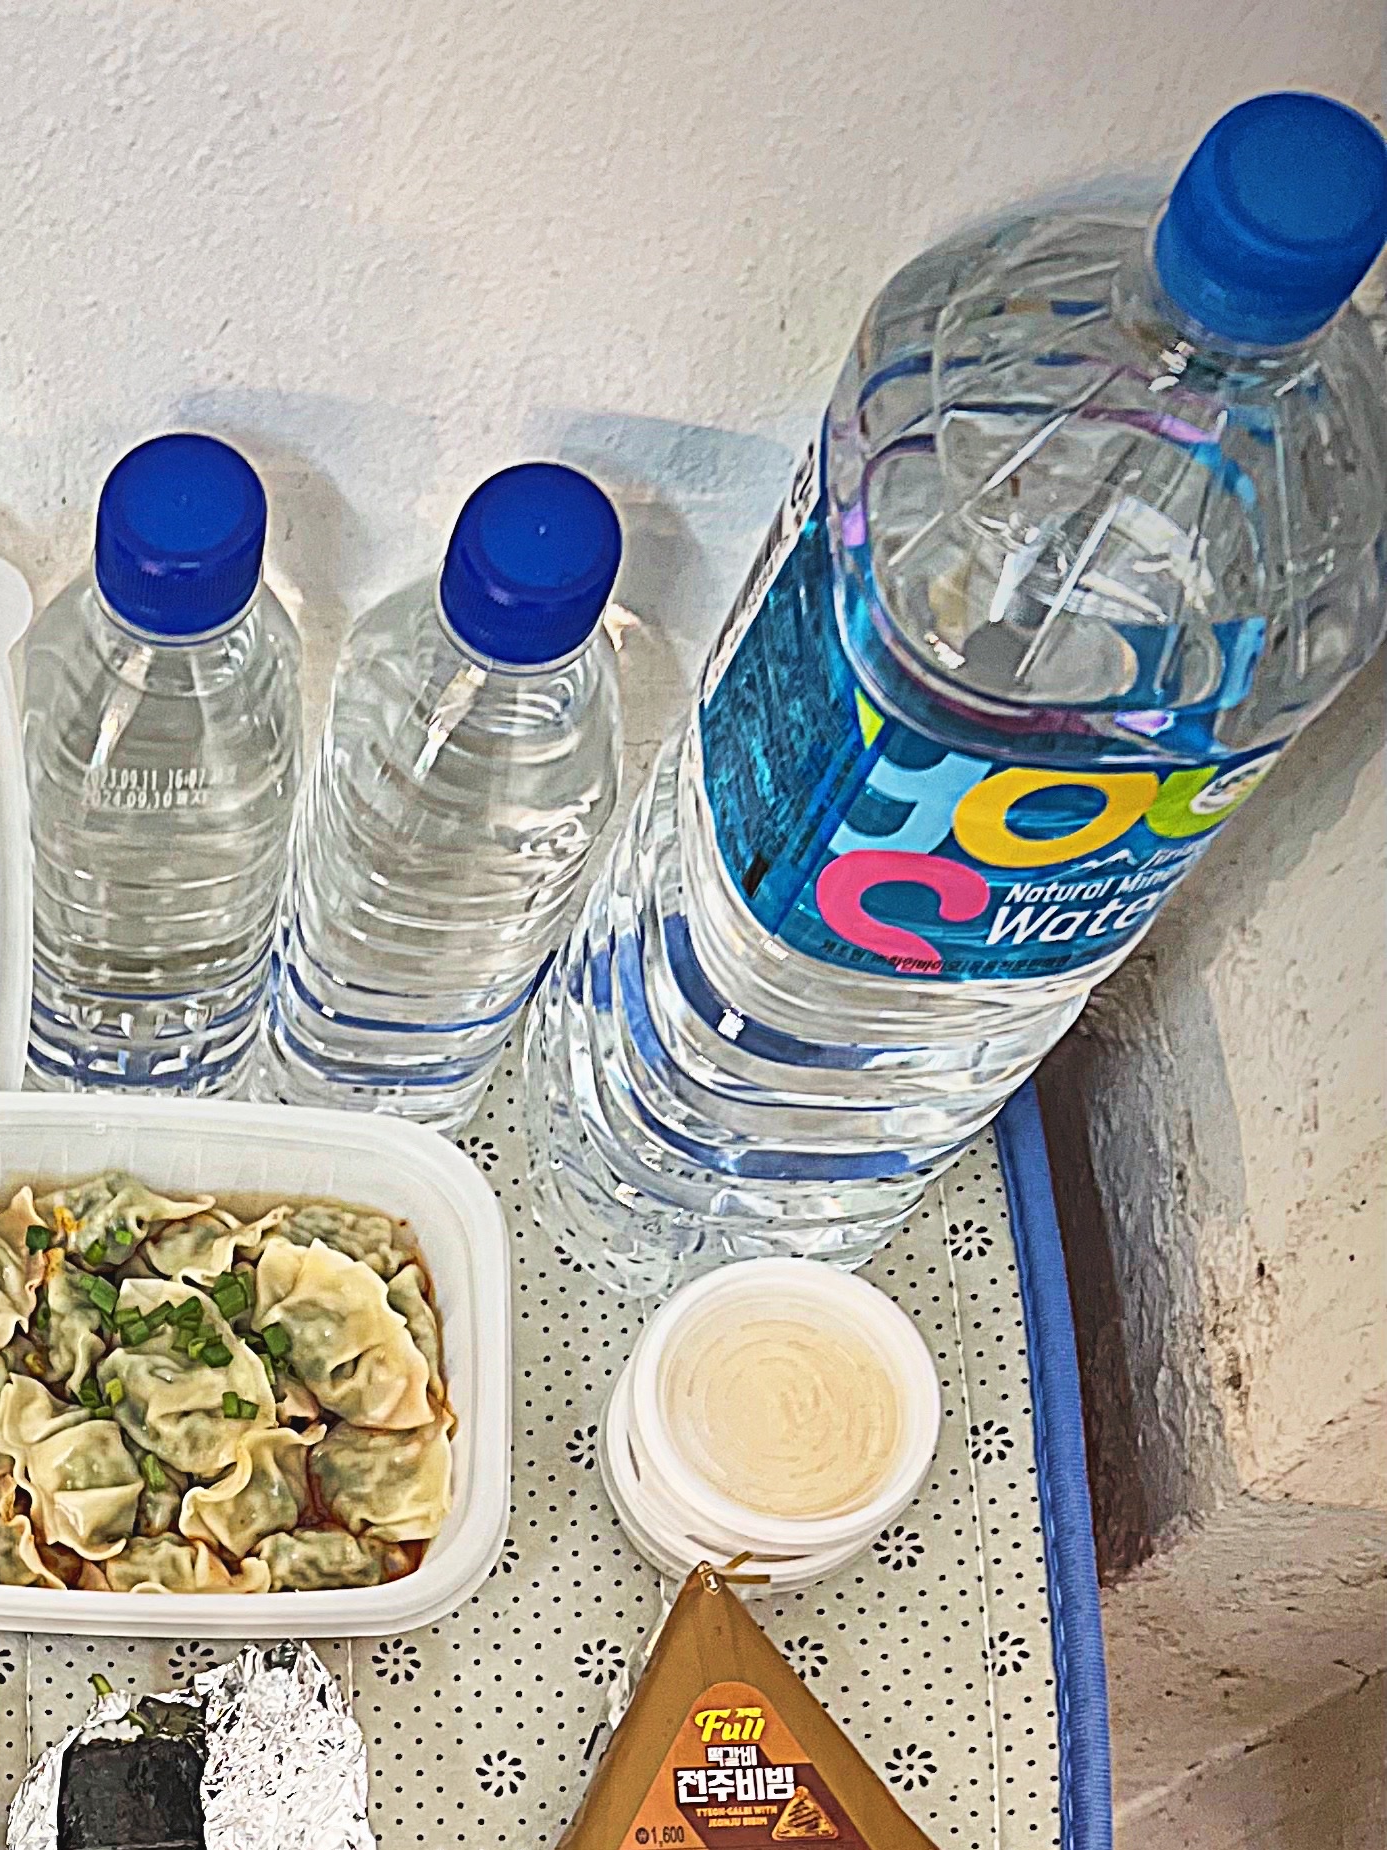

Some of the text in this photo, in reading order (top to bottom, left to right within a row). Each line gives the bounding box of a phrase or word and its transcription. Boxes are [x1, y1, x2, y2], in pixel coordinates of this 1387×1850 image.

[1004, 877, 1114, 904] Natural
[985, 891, 1162, 945] Wate
[707, 1573, 718, 1589] 1
[694, 1708, 766, 1742] Full
[707, 1745, 758, 1767] 떡갈비
[677, 1766, 795, 1804] 전주비빔
